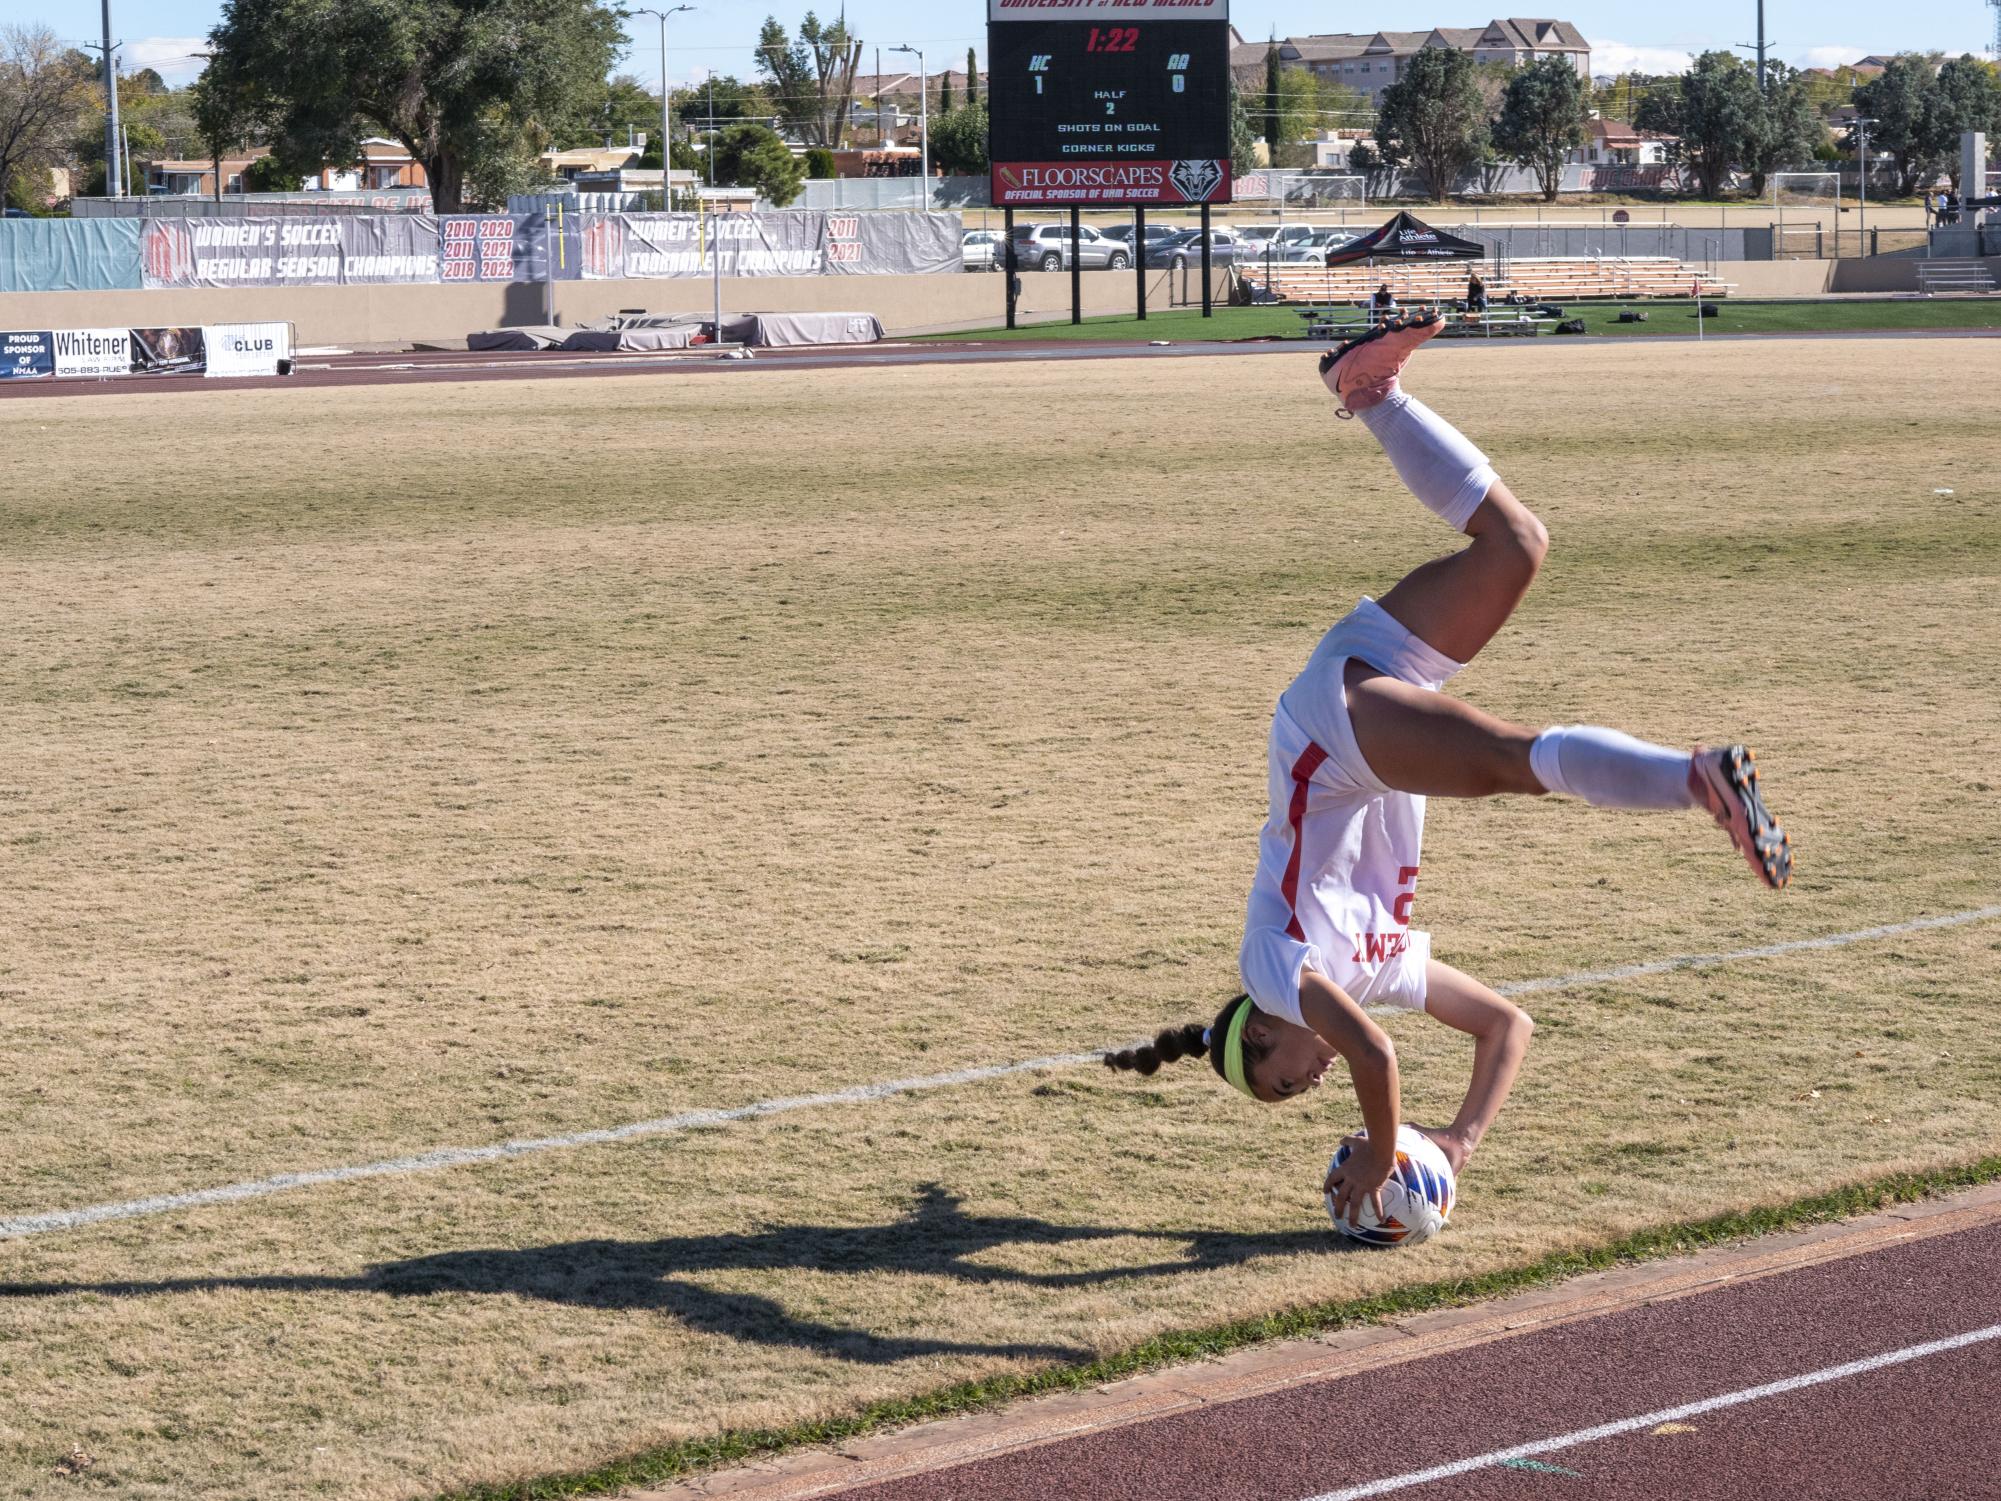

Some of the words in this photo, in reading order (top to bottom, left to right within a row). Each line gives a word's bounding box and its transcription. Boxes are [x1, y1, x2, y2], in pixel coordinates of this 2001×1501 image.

[1086, 27, 1139, 52] 1:22
[1167, 54, 1190, 70] AA
[1034, 75, 1043, 94] 1
[1172, 74, 1185, 93] 0
[1094, 91, 1127, 99] HALF
[1106, 102, 1115, 115] 2
[1058, 124, 1100, 132] SHOTS
[1104, 123, 1122, 132] ON
[1127, 123, 1161, 132] GOAL
[1062, 144, 1113, 153] CORNER
[1117, 143, 1156, 152] KICKS
[1023, 166, 1163, 187] FLOORSCAPES
[1005, 189, 1043, 200] OFFICIAL
[1046, 189, 1087, 199] SPONSOR
[1088, 189, 1101, 199] OF
[1103, 188, 1123, 198] UNM
[1126, 188, 1160, 198] SOCCER
[195, 224, 277, 247] WOMEN'S
[444, 220, 476, 239] 2010
[479, 219, 514, 239] 2020
[628, 219, 702, 241] WOMEN'S
[827, 218, 859, 239] 2011
[444, 240, 474, 259] 2011
[480, 240, 514, 259] 2021
[828, 242, 863, 262] 2021
[197, 258, 272, 280] REGULAR
[276, 256, 340, 278] SEASON
[344, 255, 438, 277] CHAMPIONS
[443, 260, 476, 280] 2018
[480, 260, 515, 279] 2022
[8, 335, 40, 344] PROUD
[56, 331, 128, 356] Whitener
[234, 339, 273, 351] CLUB
[4, 345, 45, 354] SPONSOR
[18, 356, 32, 364] OF
[13, 366, 38, 375] NMAA
